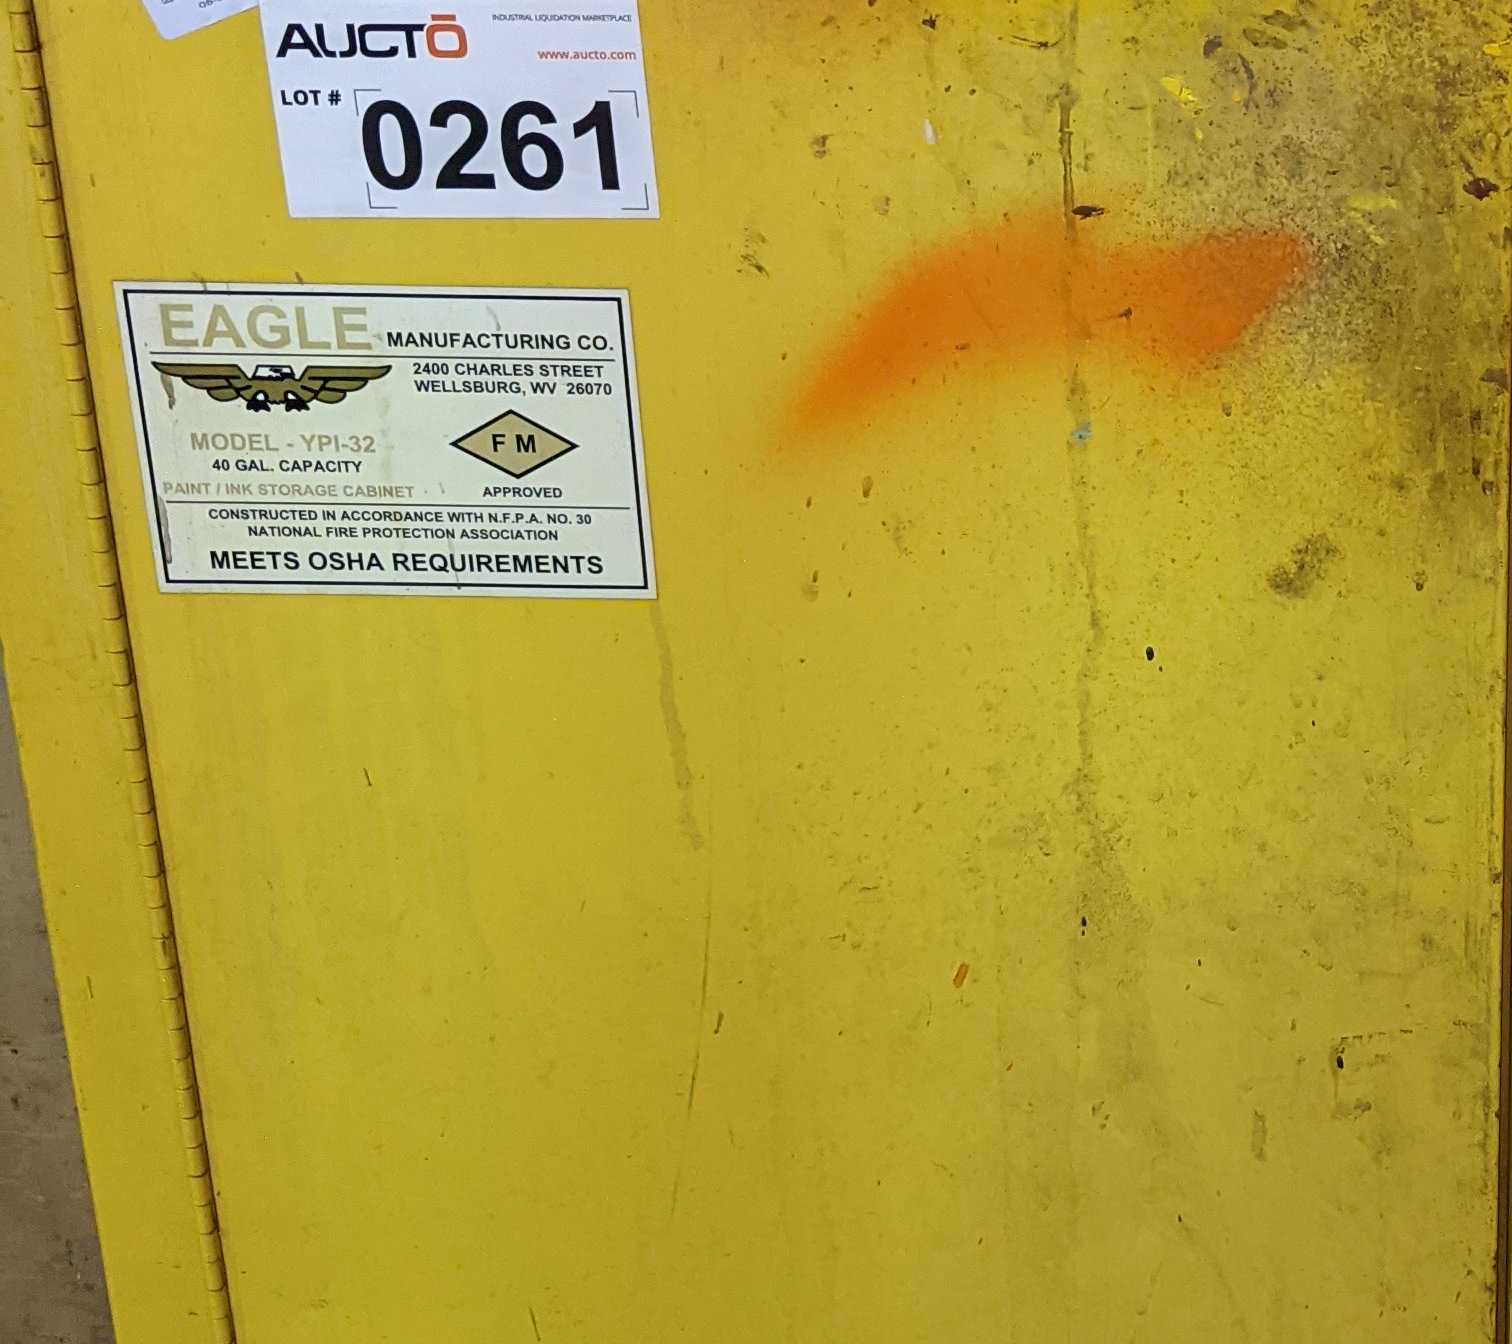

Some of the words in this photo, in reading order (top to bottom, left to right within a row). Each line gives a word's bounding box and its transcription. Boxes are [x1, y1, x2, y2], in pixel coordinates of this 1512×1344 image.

[491, 14, 533, 23] INDUSTRIAL
[534, 14, 581, 23] LIQUIDATION
[582, 14, 632, 23] MARKETPLACE
[537, 49, 637, 61] www.aucto.com
[280, 89, 321, 106] LOT
[327, 89, 342, 106] #
[361, 99, 621, 191] 0261
[159, 303, 373, 351] EAGLE
[387, 332, 571, 350] MANUFACTURING
[577, 334, 614, 351] CO.
[412, 362, 450, 376] 2400
[454, 363, 534, 377] CHARLES
[539, 364, 604, 378] STREET
[414, 379, 527, 397] WELLSBURG,
[530, 382, 557, 395] WV
[566, 383, 612, 396] 26070
[190, 431, 279, 452] MODEL
[299, 434, 377, 454] YPI-32
[212, 458, 230, 472] 40
[235, 458, 275, 472] GAL.
[279, 459, 363, 474] CAPACITY
[162, 481, 211, 495] PAINT
[225, 482, 253, 495] INK
[257, 483, 339, 498] STORAGE
[342, 484, 414, 499] CABINET
[482, 486, 563, 499] APPROVED
[208, 508, 318, 521] CONSTRUCTED
[322, 510, 336, 521] IN
[341, 510, 444, 523] ACCORDANCE
[447, 512, 484, 524] WITH
[488, 512, 543, 525] N.F.P.A.
[547, 513, 573, 525] NO.
[576, 514, 592, 525] 30
[248, 526, 322, 538] NATIONAL
[326, 527, 359, 539] FIRE
[362, 527, 456, 540] PROTECTION
[460, 528, 559, 541] ASSOCIATION
[209, 550, 300, 570] MEETS
[308, 552, 385, 572] OSHA
[392, 552, 604, 574] REQUIREMENTS
